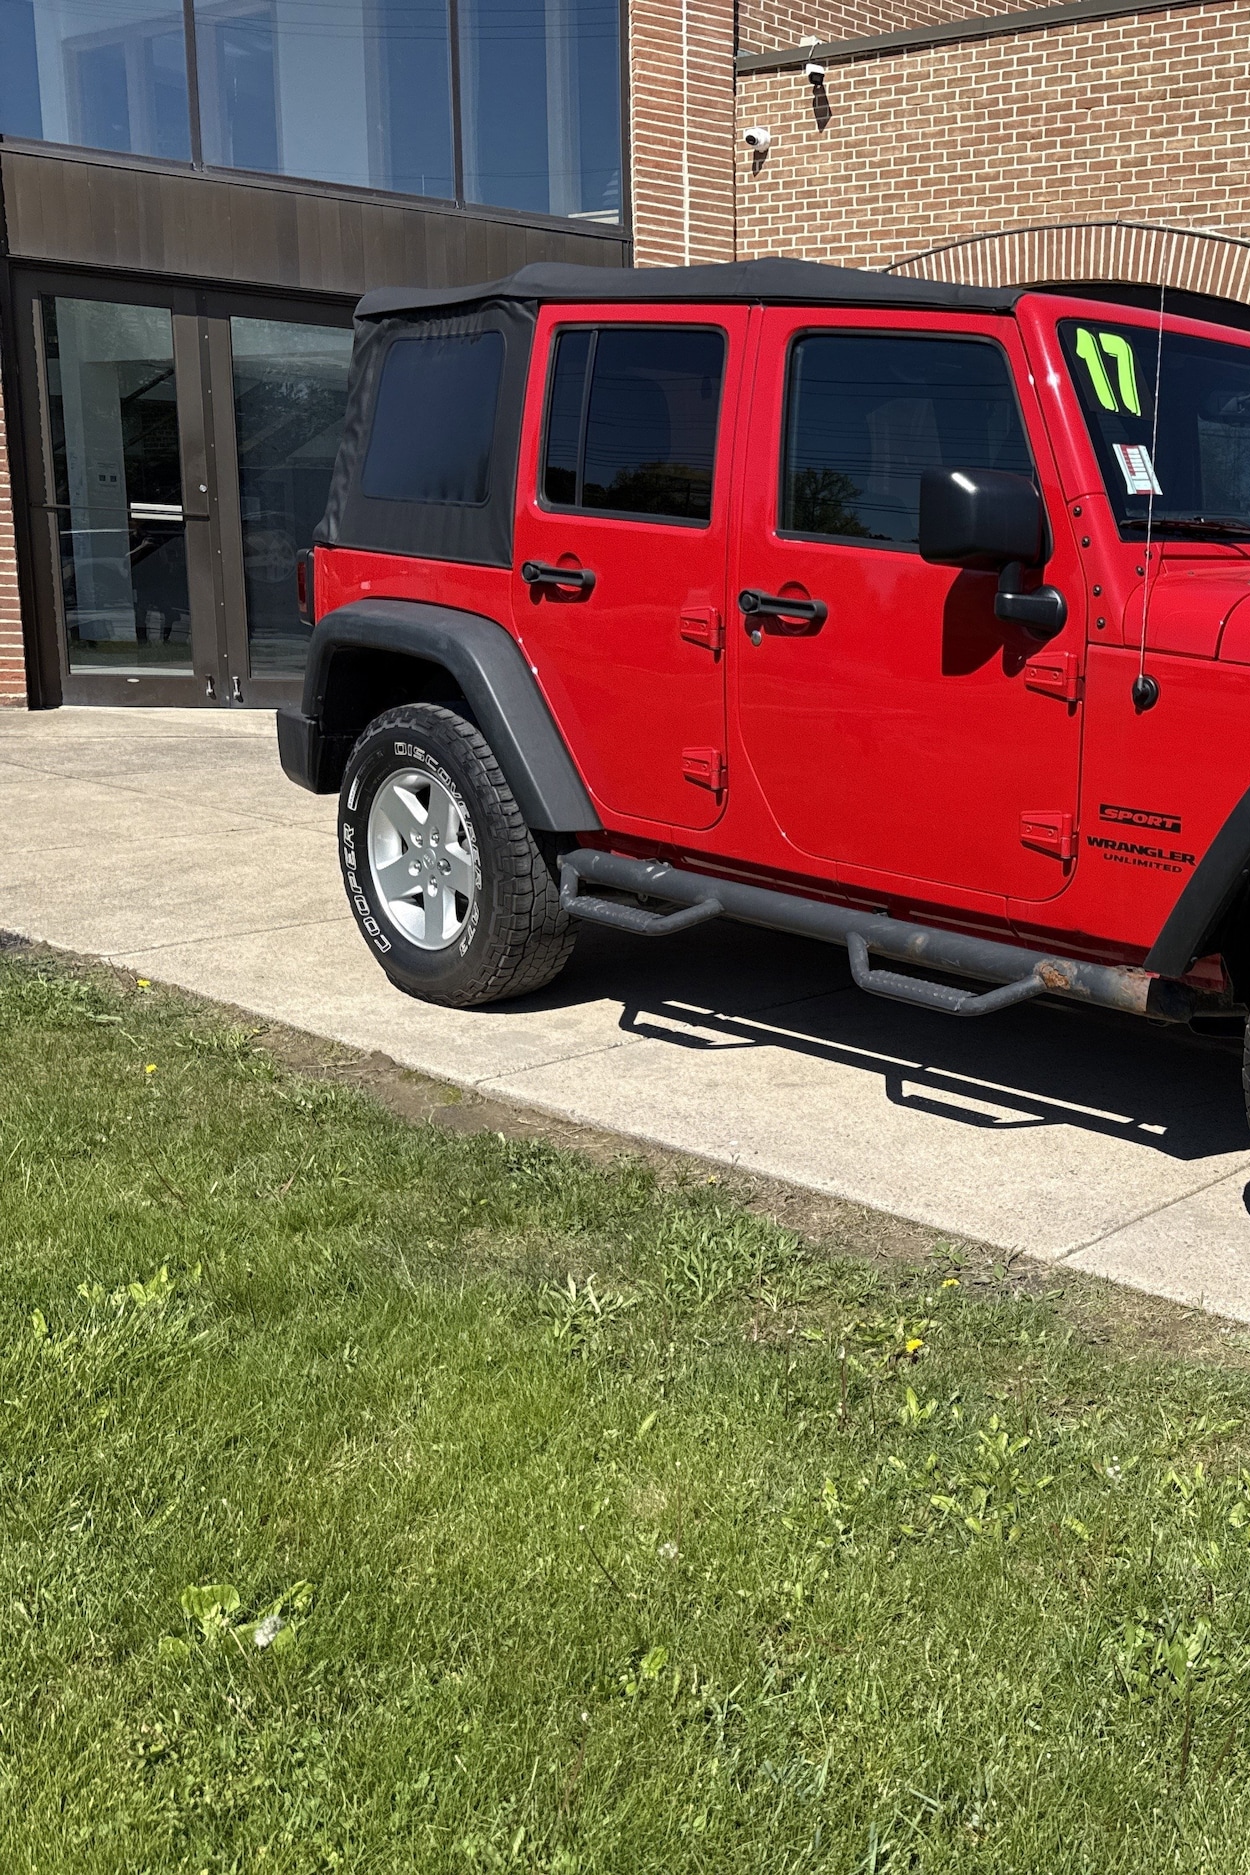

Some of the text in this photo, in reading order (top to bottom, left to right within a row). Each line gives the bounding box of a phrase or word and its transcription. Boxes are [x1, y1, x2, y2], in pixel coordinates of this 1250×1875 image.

[1076, 327, 1141, 417] 17
[394, 741, 482, 891] DISCOVERER
[1104, 807, 1180, 829] SPORT
[1086, 836, 1197, 867] WRANGLER
[1103, 853, 1182, 873] UNLIMITED
[343, 823, 392, 954] COOPER
